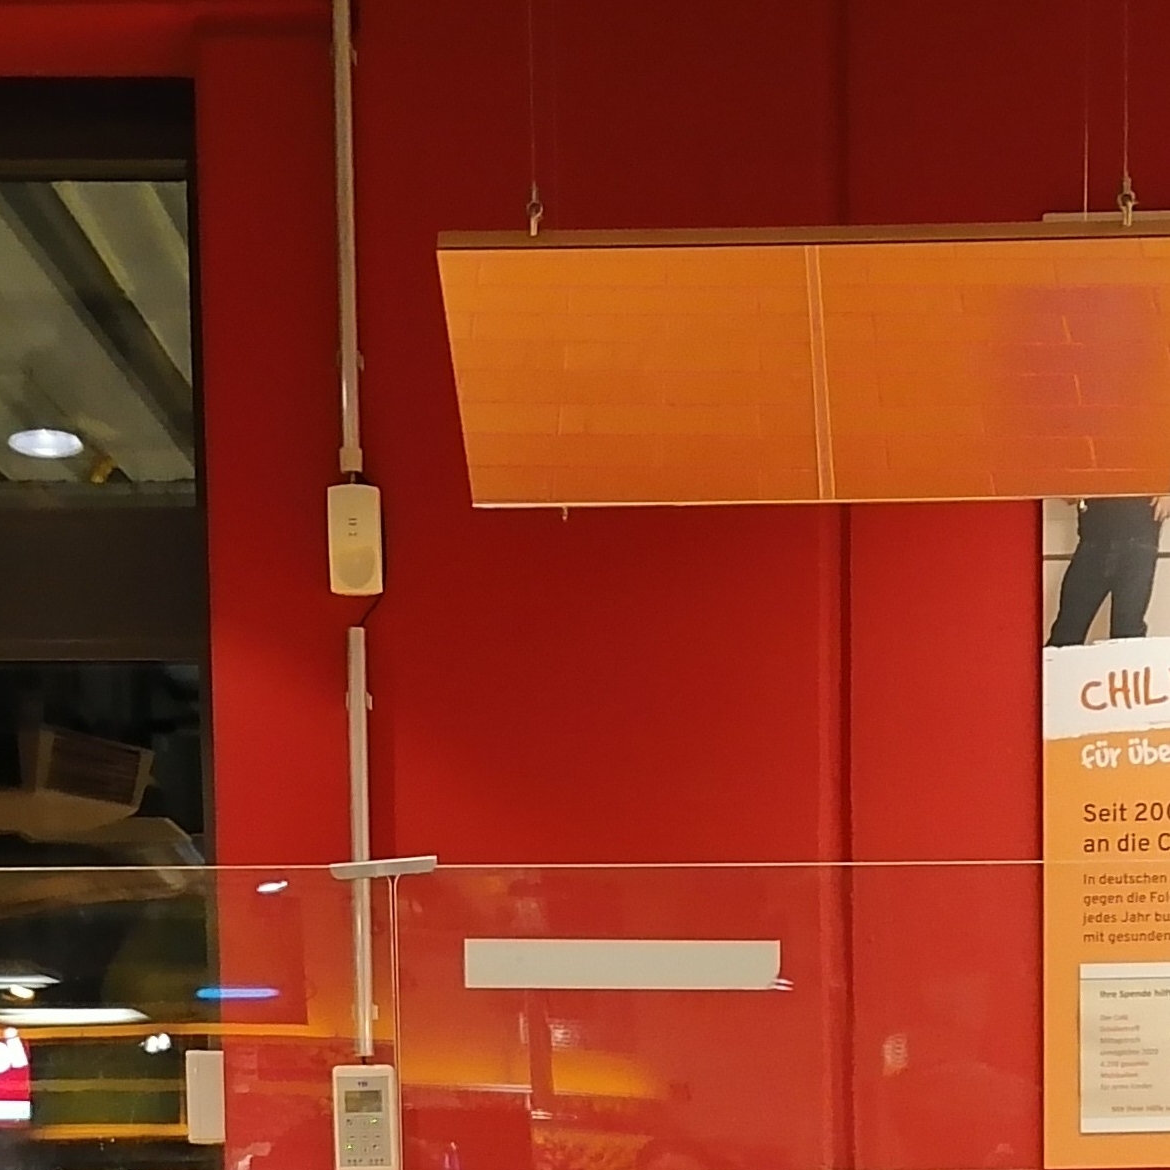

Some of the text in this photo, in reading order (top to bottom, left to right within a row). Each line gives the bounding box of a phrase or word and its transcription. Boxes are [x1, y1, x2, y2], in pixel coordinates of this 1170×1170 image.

[1081, 666, 1170, 710] CHIL
[1081, 740, 1122, 769] für
[1083, 803, 1128, 822] Seit
[1083, 838, 1109, 853] an
[1117, 833, 1150, 852] die
[1083, 873, 1168, 885] In deutschen
[1083, 894, 1123, 907] gegen
[1127, 892, 1146, 903] die
[1082, 912, 1117, 926] jedes
[1121, 911, 1151, 923] Jahr
[1083, 930, 1170, 944] mit gesunden
[1119, 990, 1151, 999] Spende
